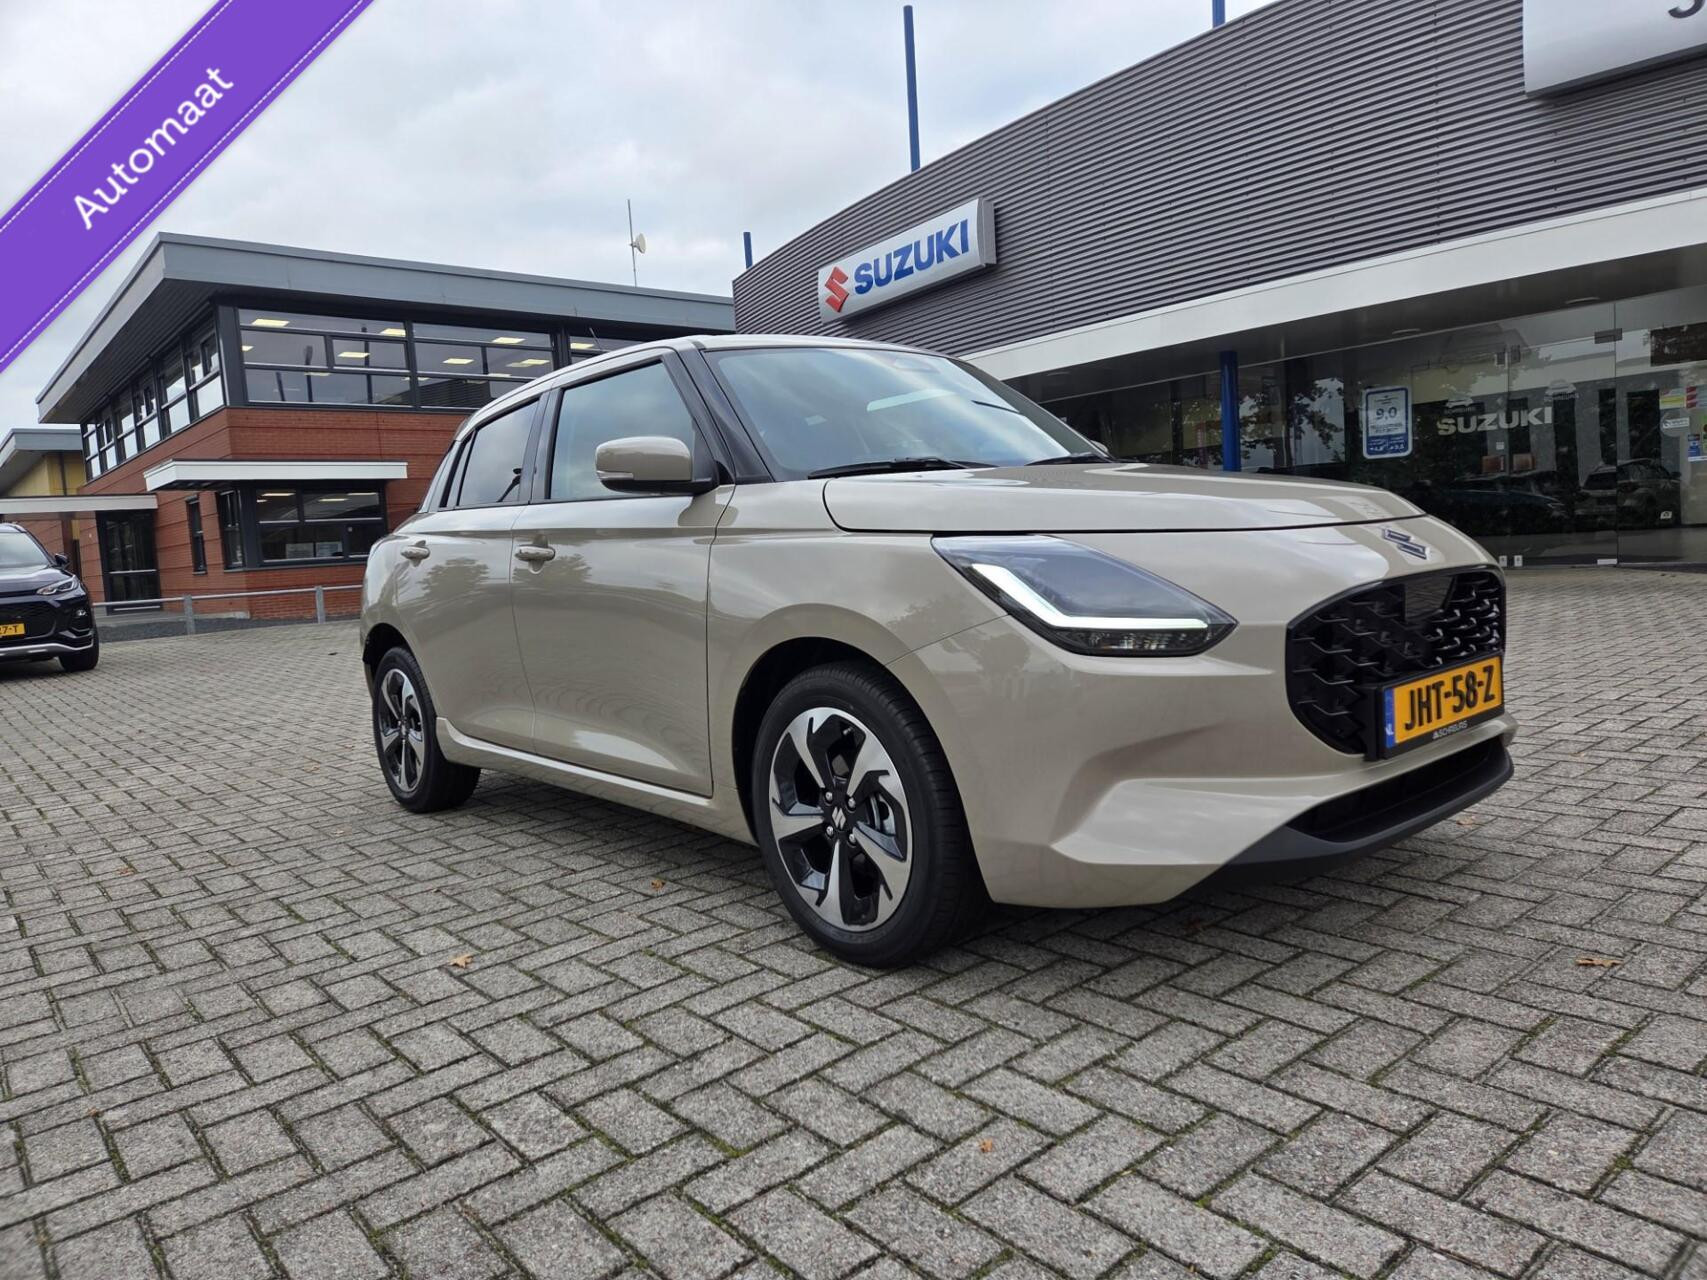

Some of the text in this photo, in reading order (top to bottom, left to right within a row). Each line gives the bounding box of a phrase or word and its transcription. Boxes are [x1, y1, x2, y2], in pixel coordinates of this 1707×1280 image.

[854, 219, 970, 295] SUZUKI
[1436, 406, 1553, 436] SUZUKI
[1404, 665, 1496, 731] JHT-58-Z
